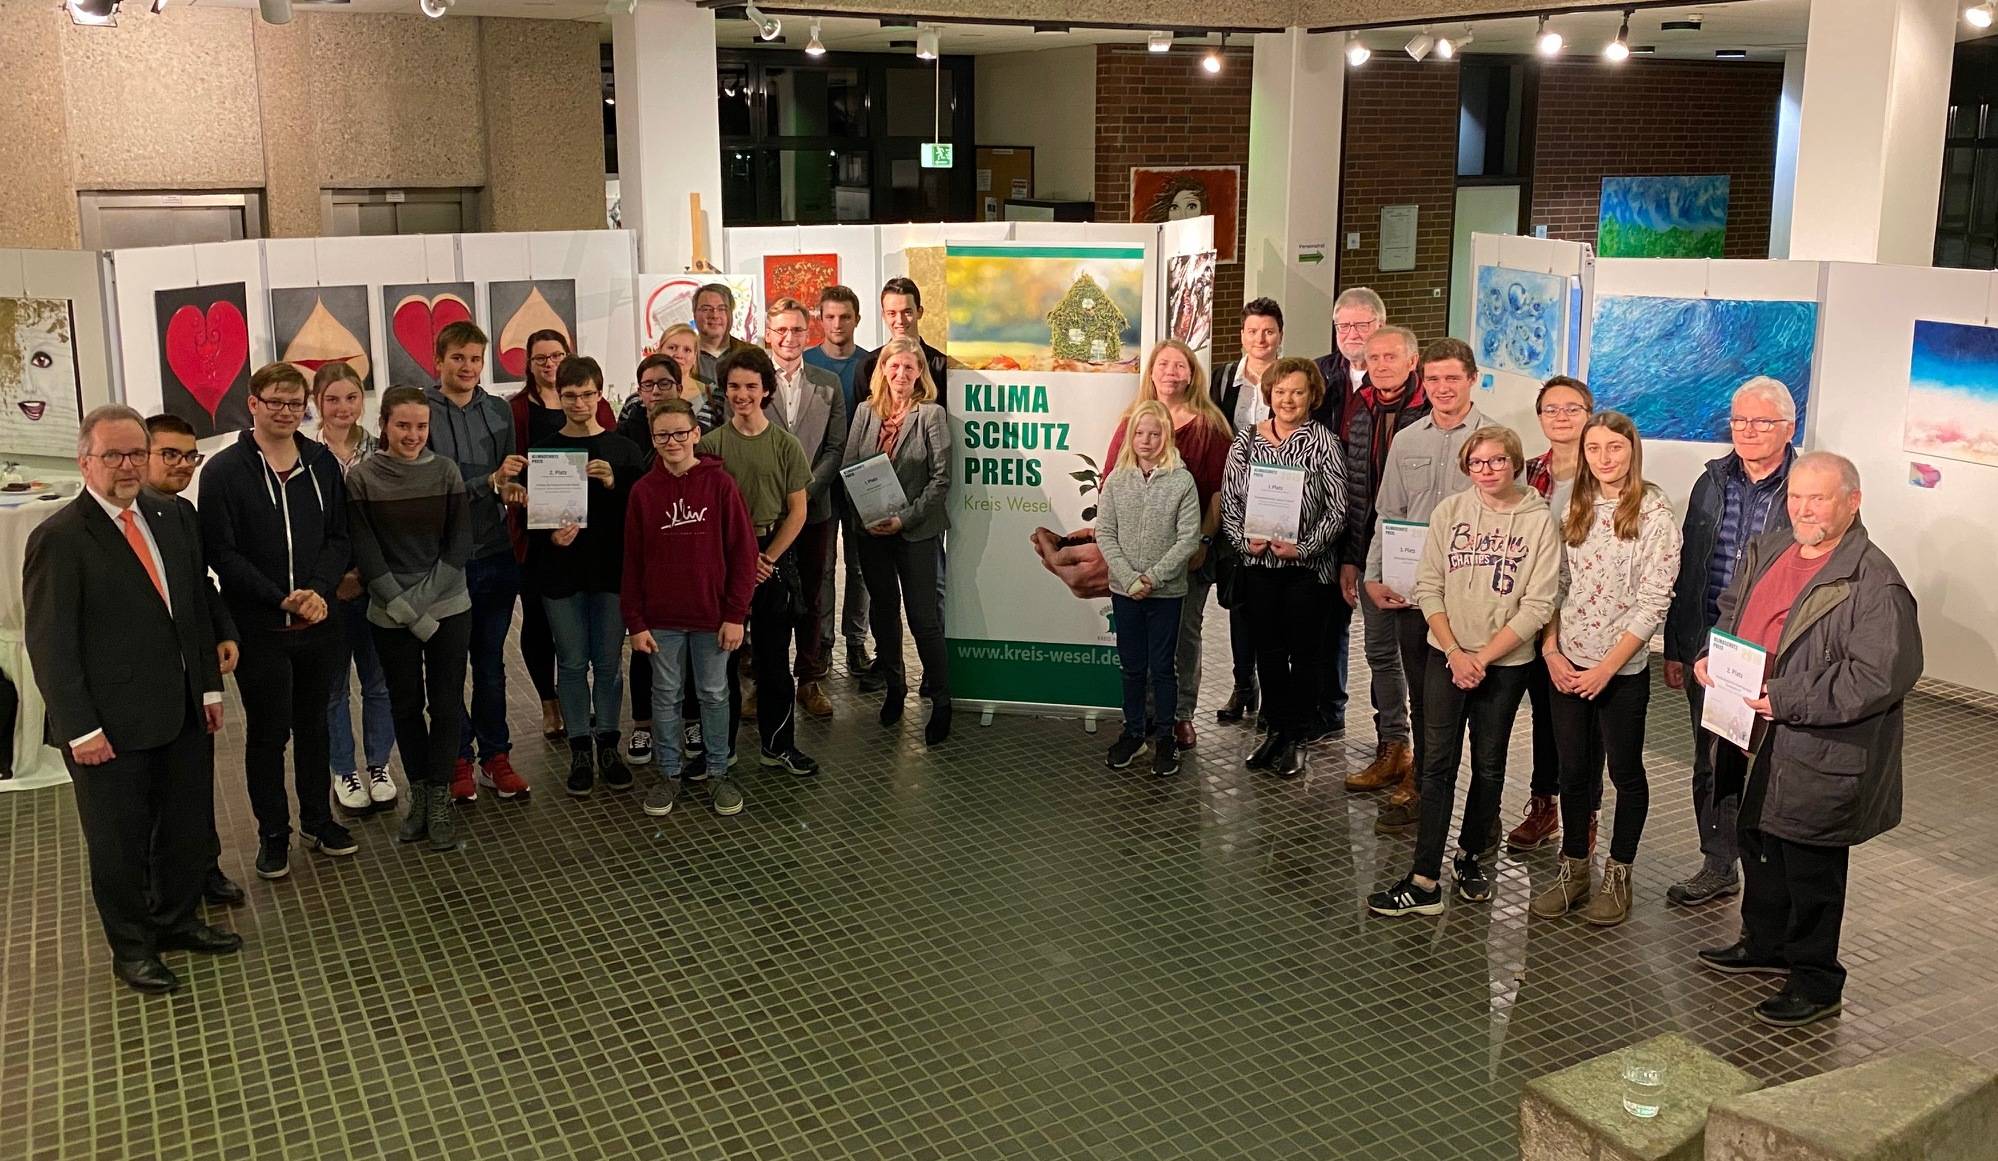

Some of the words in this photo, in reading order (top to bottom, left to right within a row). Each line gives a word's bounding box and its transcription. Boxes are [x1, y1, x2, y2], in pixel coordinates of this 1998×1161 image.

[965, 384, 1049, 413] KLIMA
[964, 420, 1070, 451] SCHUTZ
[964, 457, 1042, 487] PREIS
[964, 495, 1001, 511] Kreis
[1007, 496, 1052, 513] Wesel
[958, 644, 1121, 666] www.kreis-wesel.de
